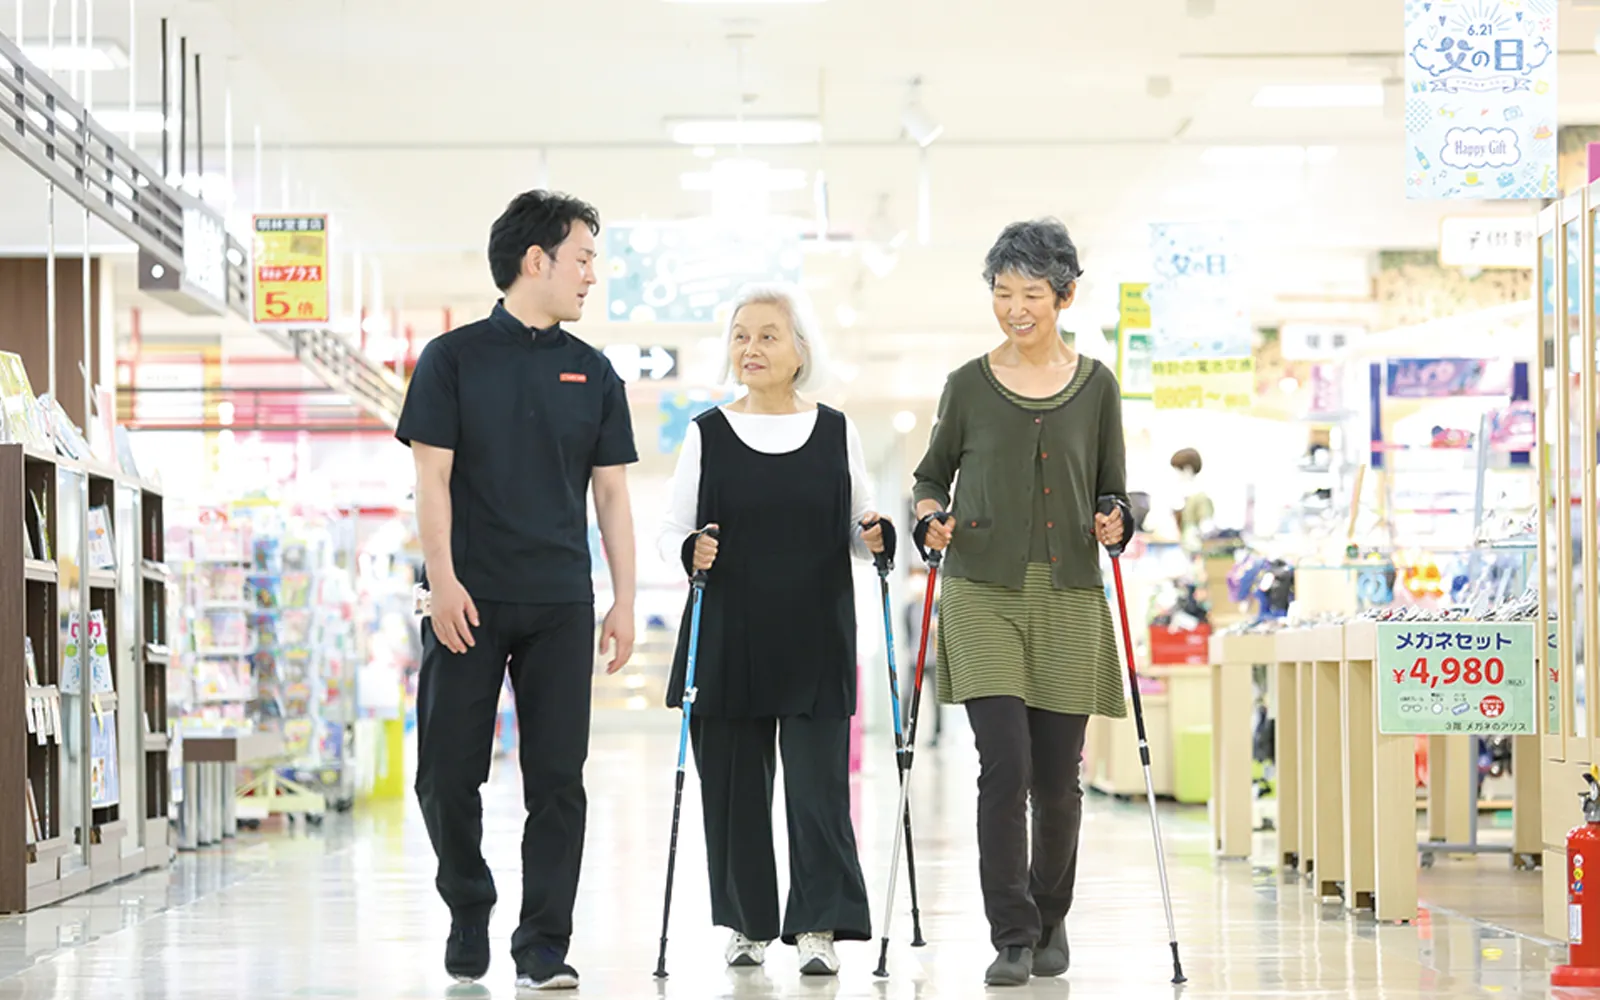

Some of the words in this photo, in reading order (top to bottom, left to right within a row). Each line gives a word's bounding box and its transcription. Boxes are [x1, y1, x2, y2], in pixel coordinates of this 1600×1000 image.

[1467, 24, 1493, 37] 6.21
[1435, 36, 1524, 73] 父の日
[1455, 140, 1486, 157] Happy
[1488, 139, 1507, 155] Gift
[1396, 632, 1512, 650] メガネセット
[1393, 656, 1505, 689] ¥4,980
[1466, 721, 1527, 732] メガネのアリス
